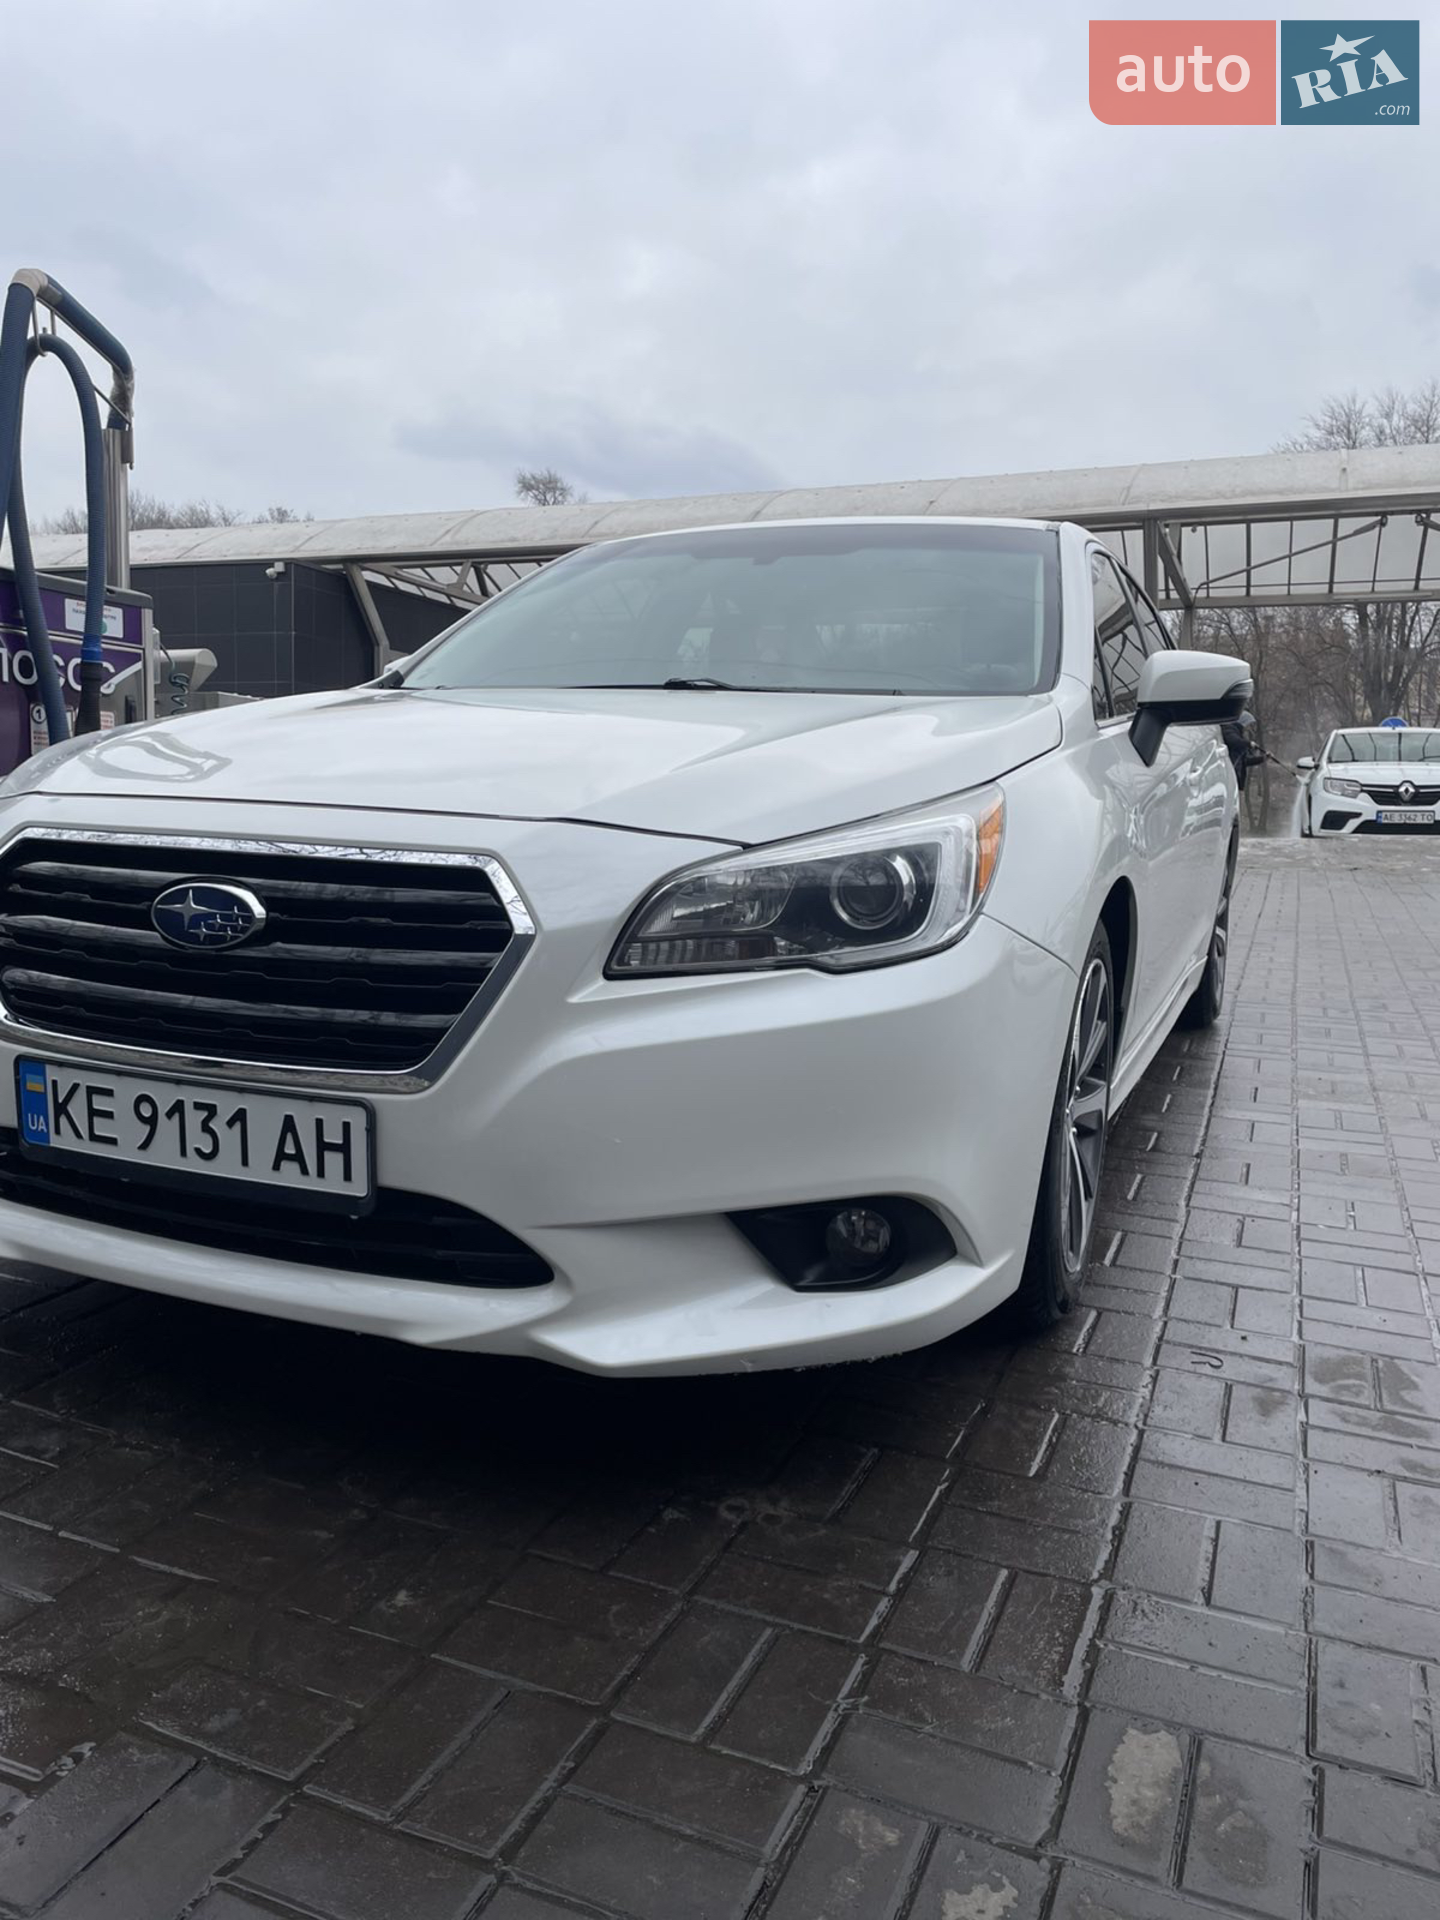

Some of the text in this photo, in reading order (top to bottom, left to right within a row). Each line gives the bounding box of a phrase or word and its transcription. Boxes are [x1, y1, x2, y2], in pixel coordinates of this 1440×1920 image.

[28, 1112, 48, 1134] UA
[51, 1079, 353, 1182] KE 9131 AH
